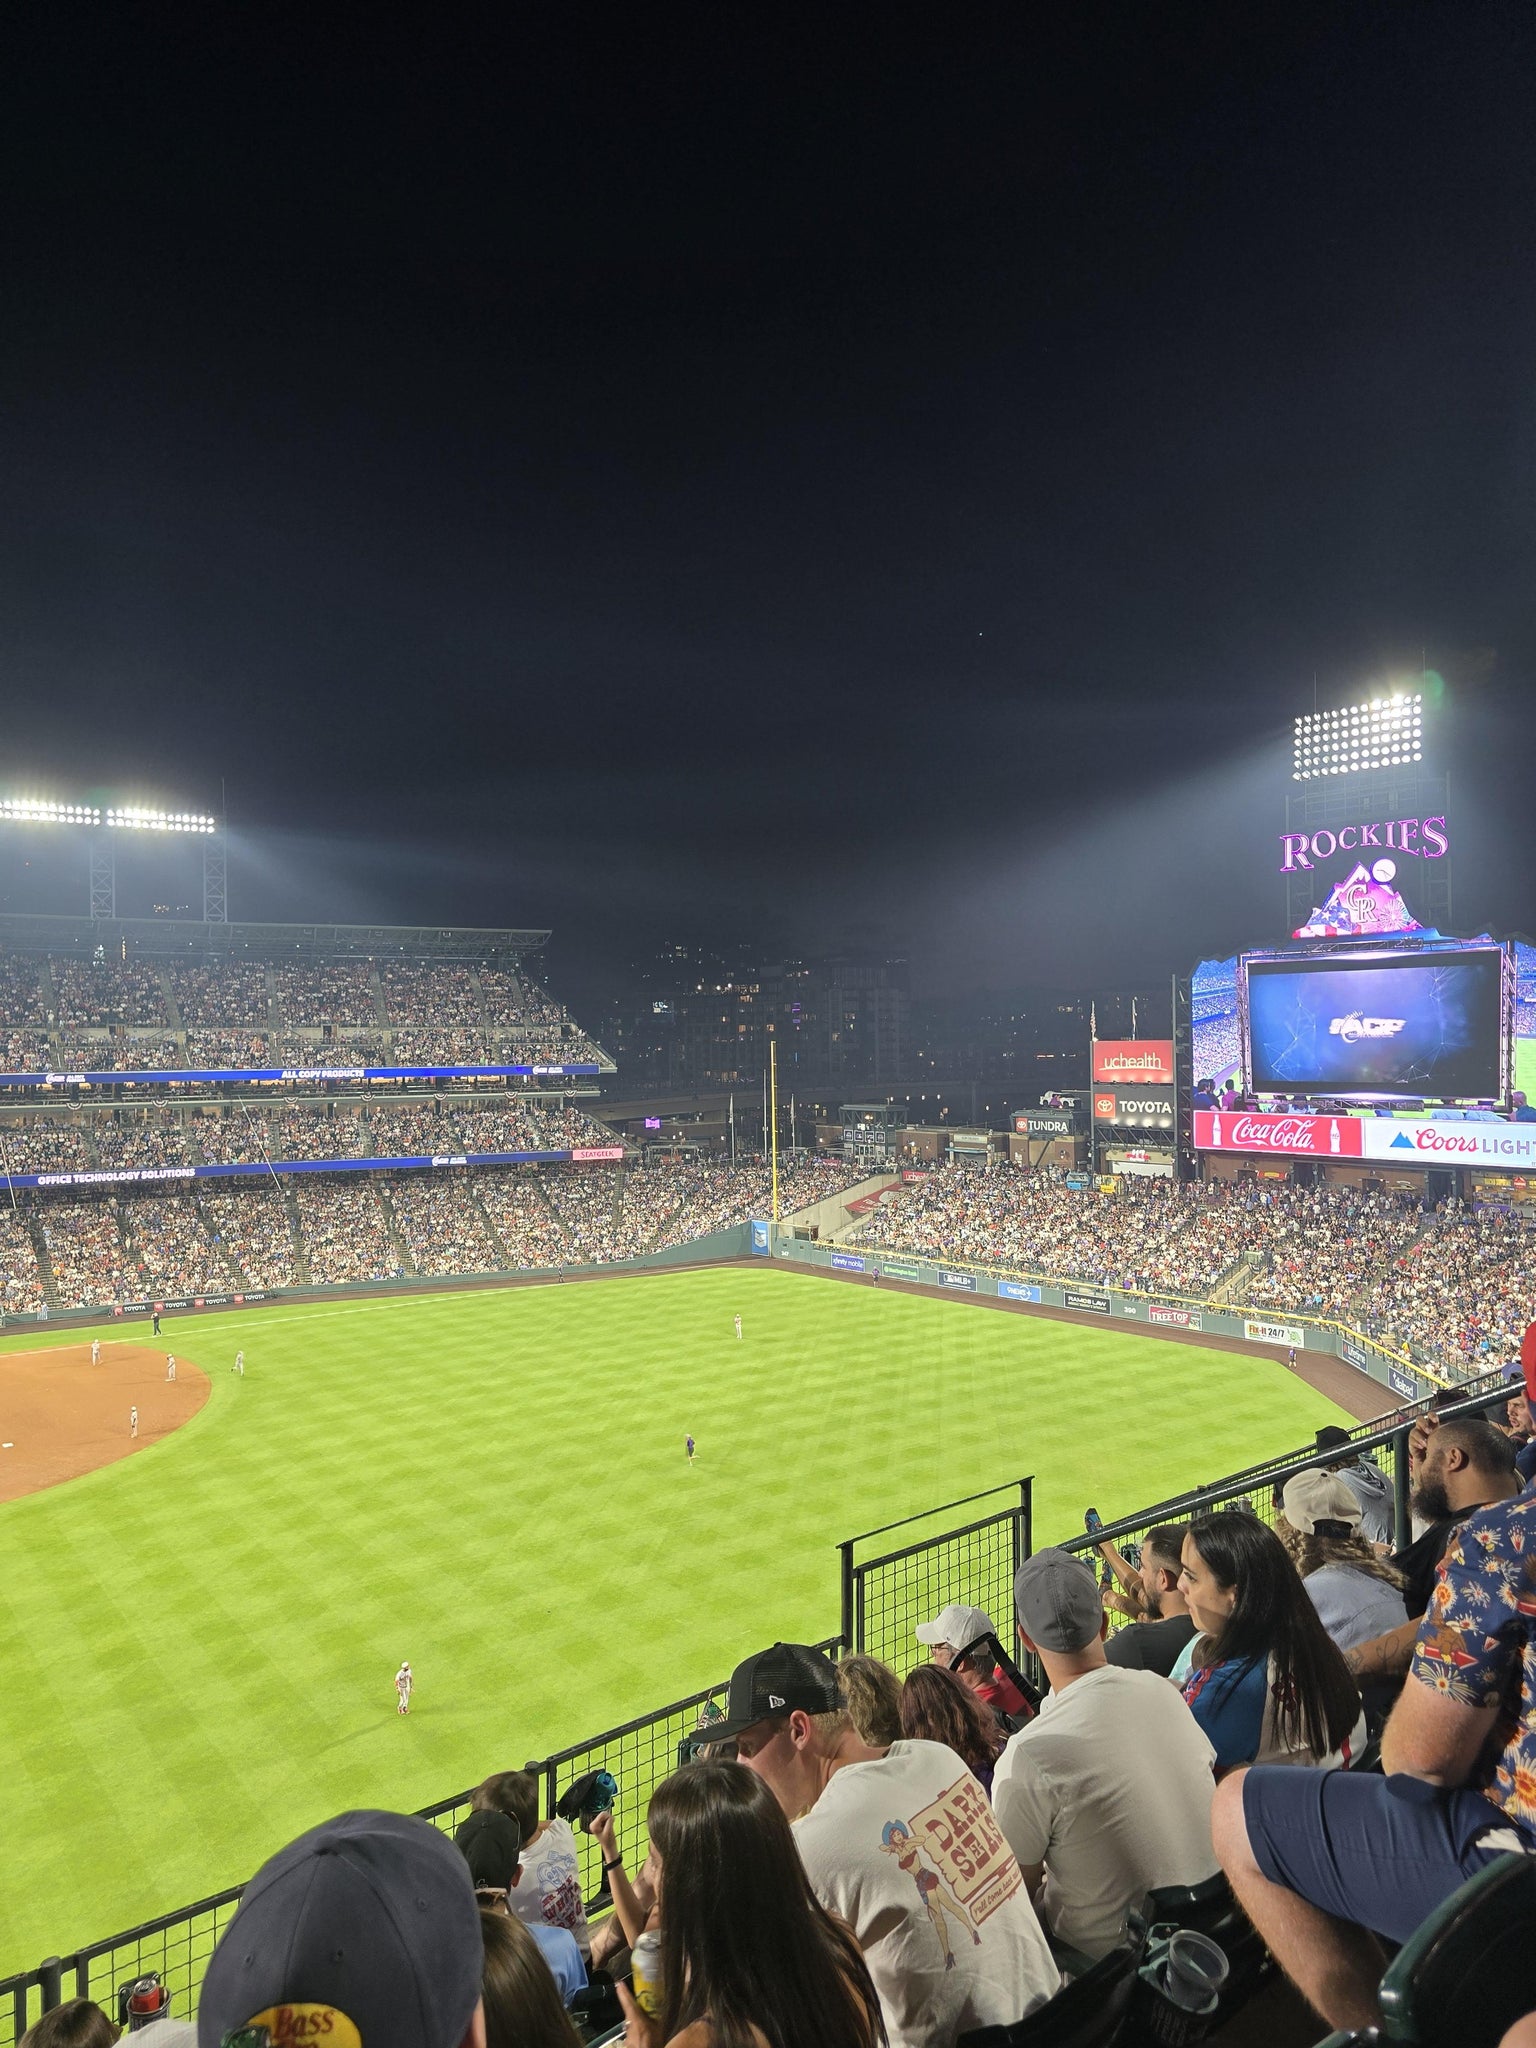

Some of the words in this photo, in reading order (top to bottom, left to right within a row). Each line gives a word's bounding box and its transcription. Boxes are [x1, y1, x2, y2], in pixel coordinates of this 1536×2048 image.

[1279, 816, 1449, 871] ROCKIES
[1104, 1052, 1162, 1069] uchealth
[281, 1070, 298, 1078] ALL
[298, 1070, 321, 1078] COPY
[321, 1069, 365, 1078] PRODUCTS
[1119, 1100, 1173, 1114] TOYOTA
[1028, 1119, 1069, 1133] TUNDRA
[1231, 1116, 1314, 1149] Coca-Cola
[1415, 1128, 1479, 1153] Coors
[1482, 1138, 1536, 1155] LIGH
[581, 1150, 614, 1158] SEATGEEK
[37, 1175, 72, 1185] OFFICE
[73, 1171, 140, 1183] TECHNOLOGY
[141, 1168, 196, 1179] SOLUTIONS
[832, 1257, 847, 1267] xfinity
[847, 1259, 864, 1269] mobile
[206, 1298, 227, 1306] TOYOTA
[245, 1293, 265, 1301] TOYOTA
[1068, 1295, 1091, 1305] RAMOS
[124, 1304, 146, 1312] TOYOTA
[165, 1301, 187, 1309] TOYOTA
[1267, 1327, 1285, 1338] 24/7
[925, 1782, 987, 1853] DARK
[950, 1813, 1004, 1883] SEAS
[273, 2007, 335, 2039] Bass
